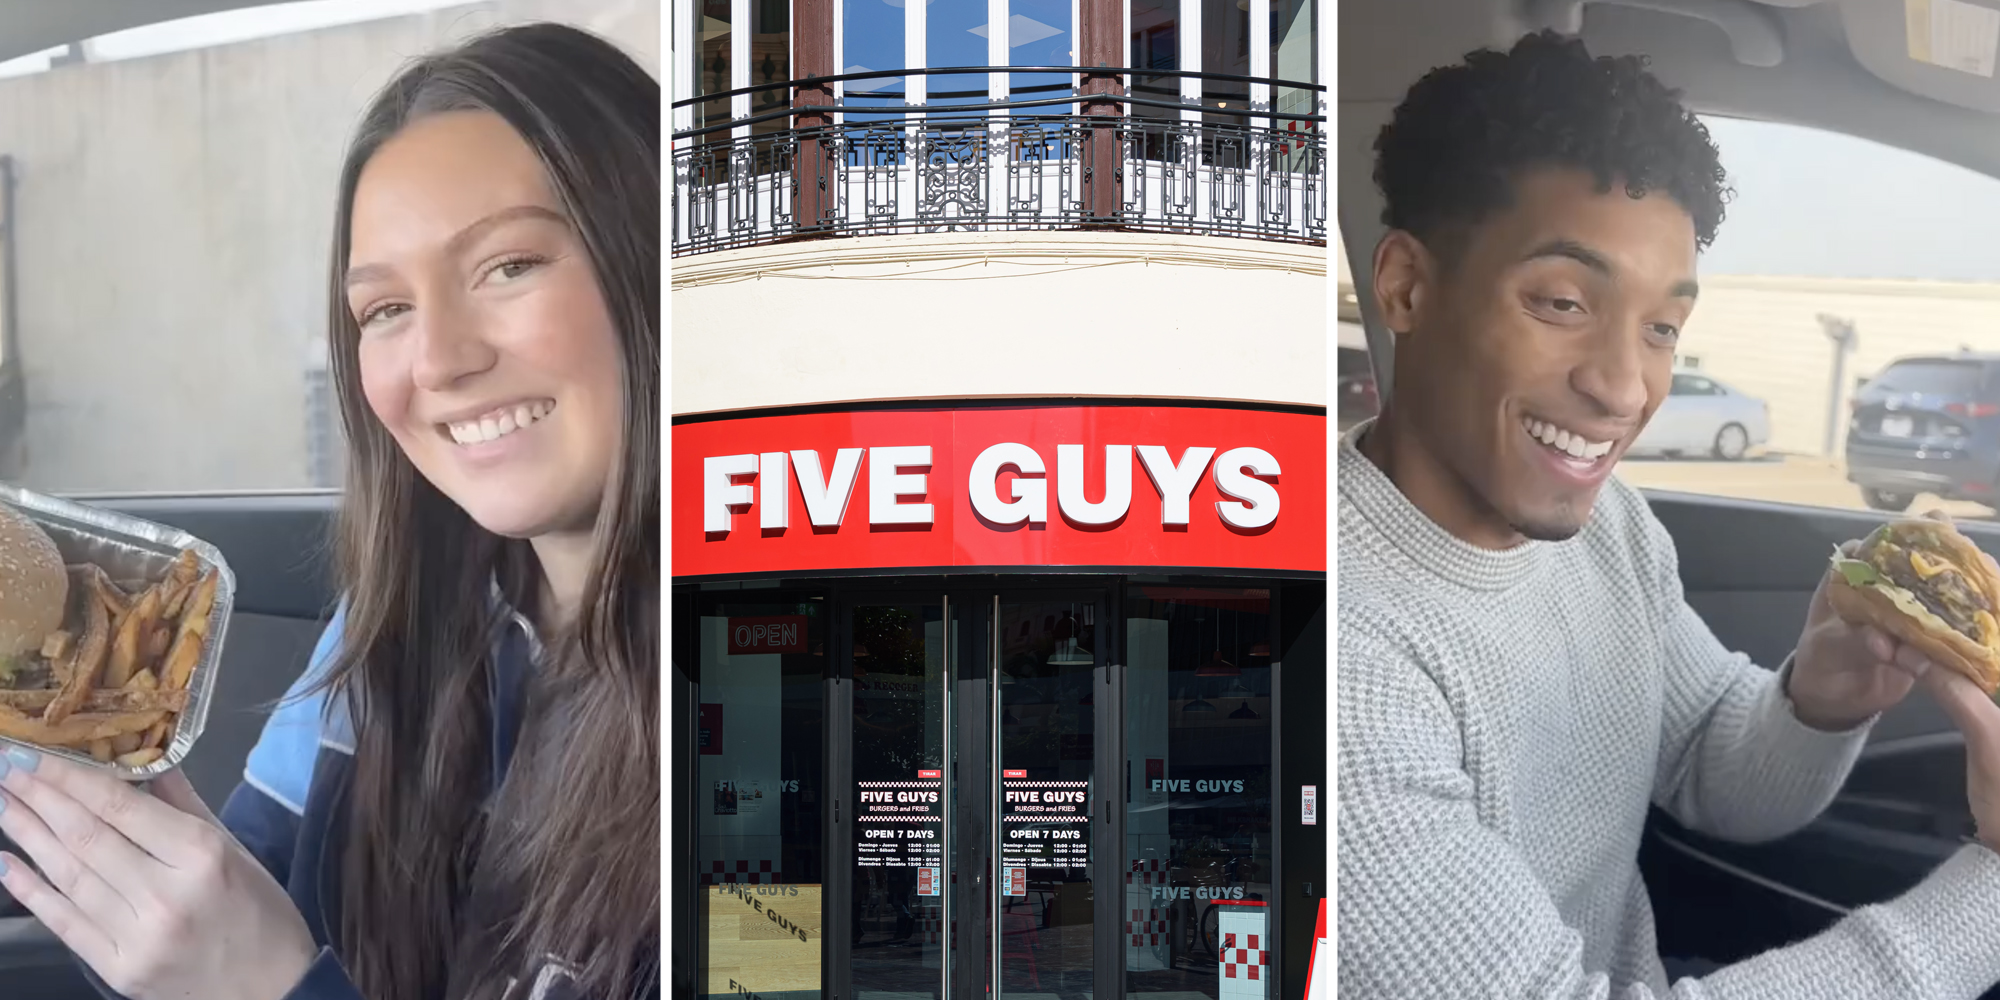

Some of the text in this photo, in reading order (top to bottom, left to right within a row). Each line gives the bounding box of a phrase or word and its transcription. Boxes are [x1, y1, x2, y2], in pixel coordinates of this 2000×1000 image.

[703, 442, 1283, 536] FIVE GUYS
[734, 623, 798, 648] OPEN
[874, 682, 918, 692] RECOGER
[720, 780, 750, 792] FIV
[1152, 780, 1244, 793] FIVE GUYS
[861, 792, 938, 802] FIVE GUYS
[1006, 792, 1085, 802] FIVE GUYS
[865, 830, 934, 838] OPEN 7 DAYS
[1010, 830, 1080, 838] OPEN 7 DAYS
[719, 882, 799, 896] FIVE GUYS
[1152, 886, 1244, 900] FIVE GUYS
[766, 908, 808, 942] GUYS
